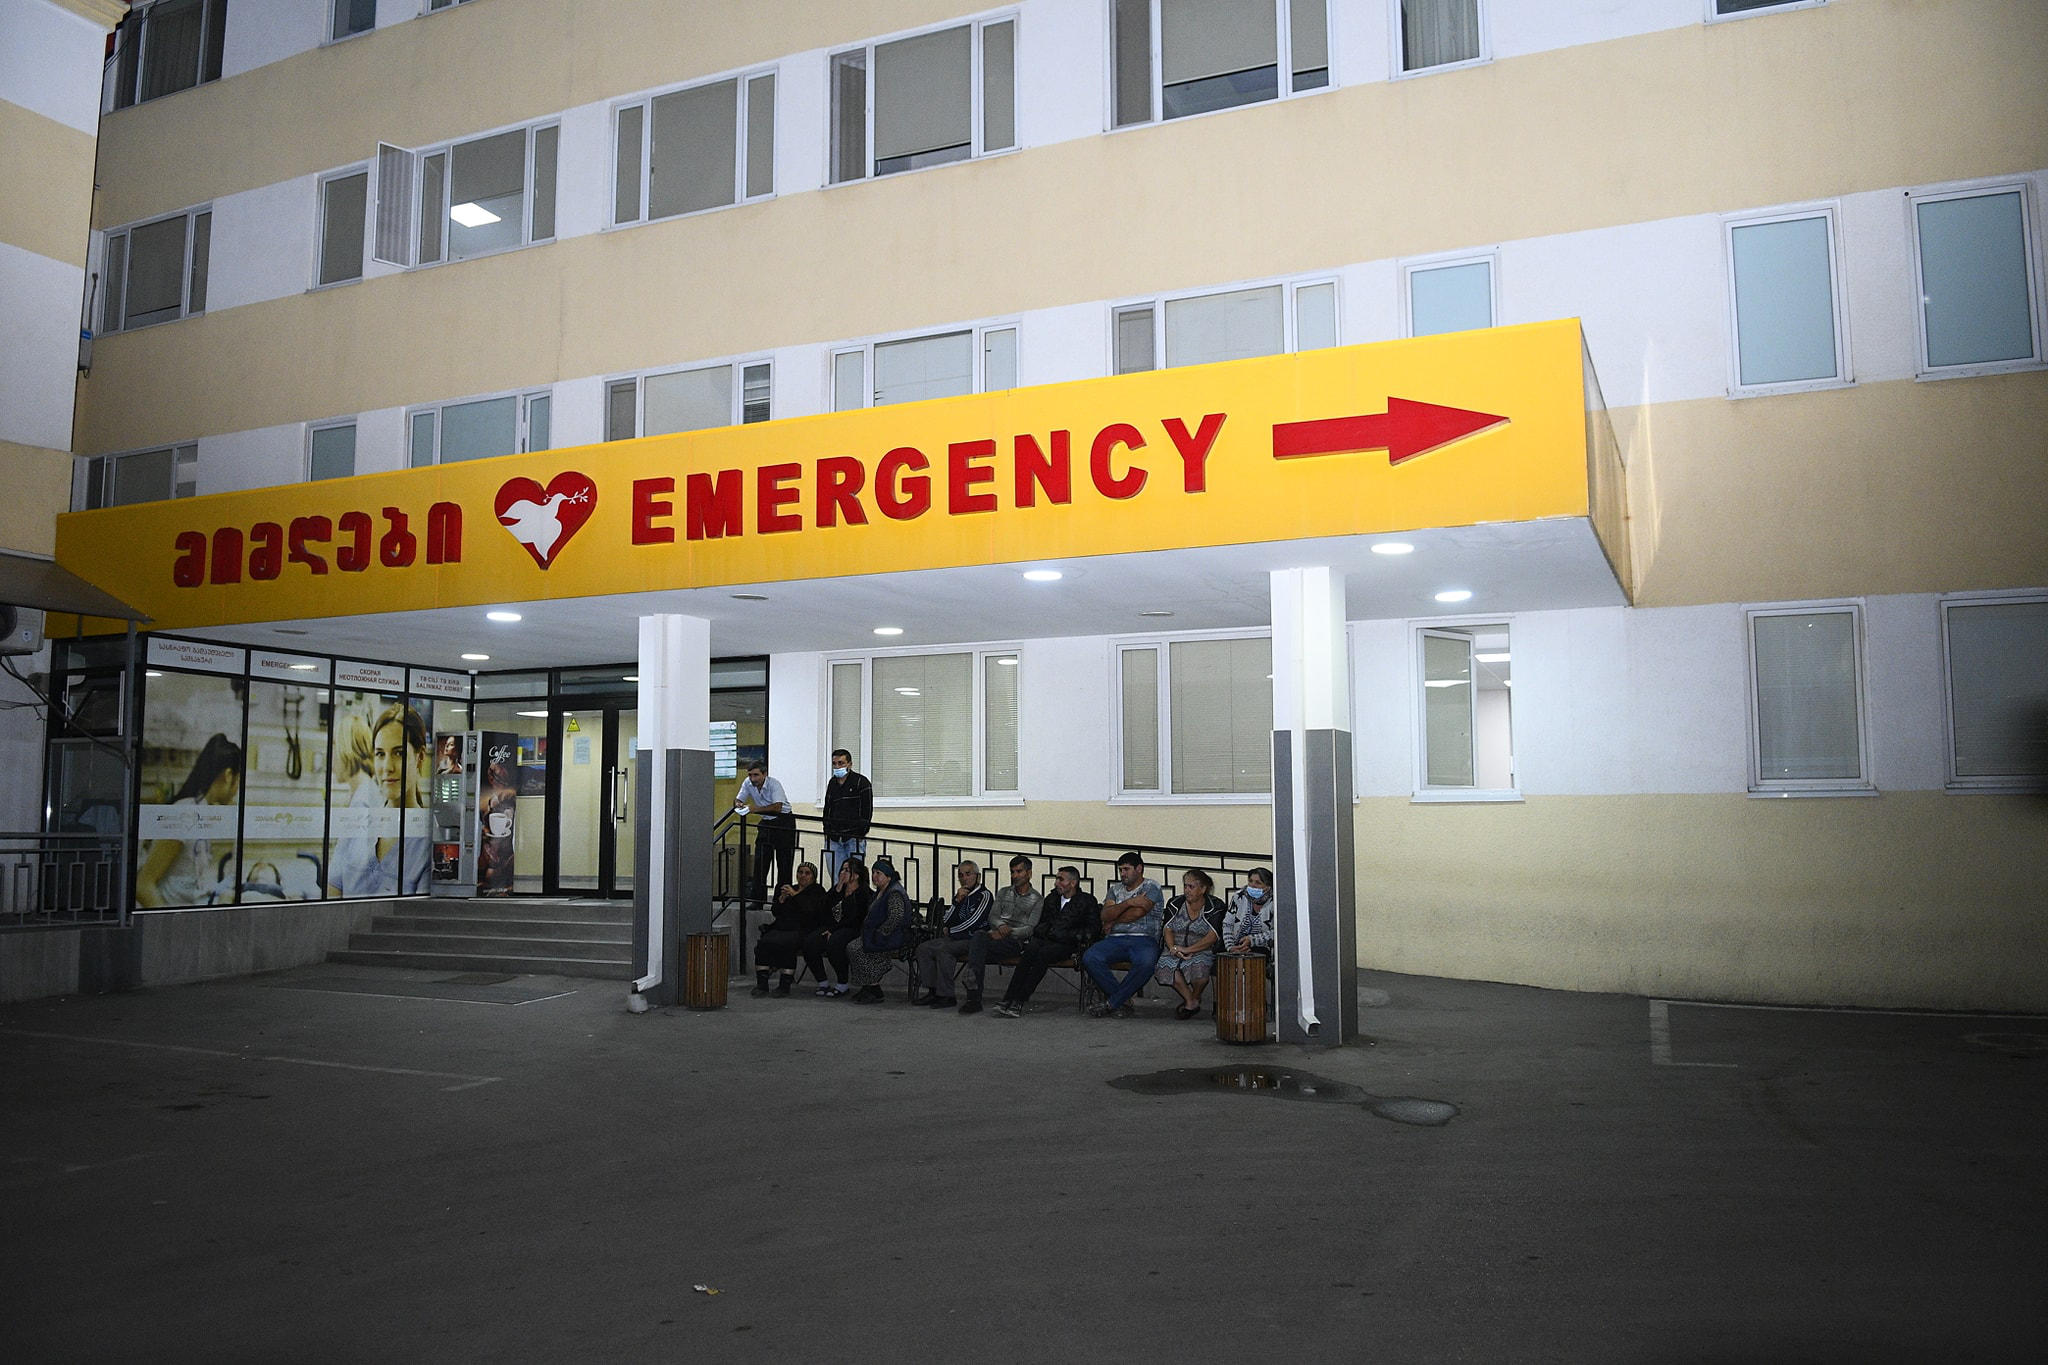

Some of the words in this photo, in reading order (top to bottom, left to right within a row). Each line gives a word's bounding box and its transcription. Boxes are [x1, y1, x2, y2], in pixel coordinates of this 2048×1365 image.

[631, 412, 1227, 546] EMERGENCY
[173, 502, 463, 588] მიმღები
[489, 745, 511, 762] Coffee
